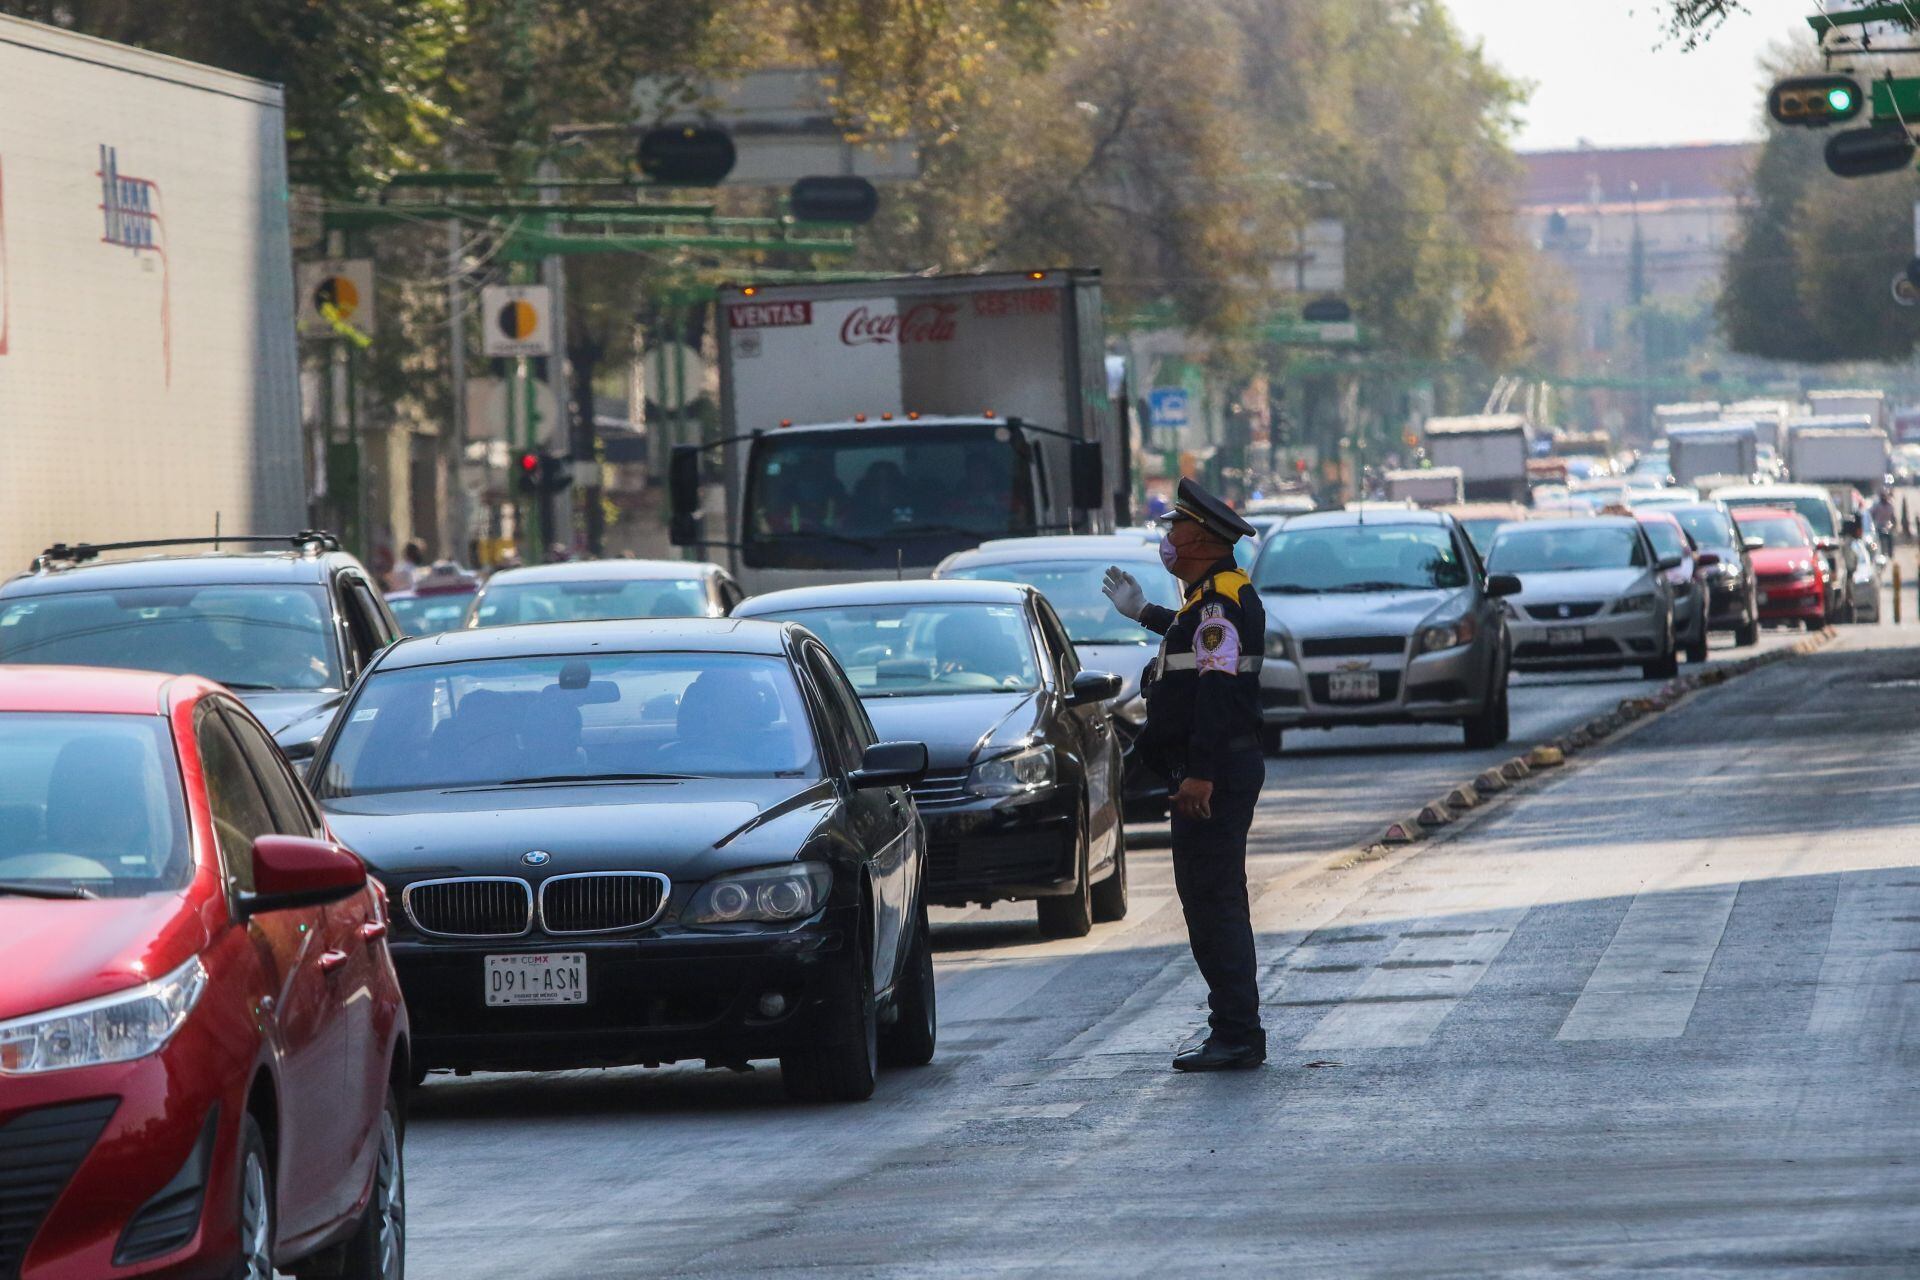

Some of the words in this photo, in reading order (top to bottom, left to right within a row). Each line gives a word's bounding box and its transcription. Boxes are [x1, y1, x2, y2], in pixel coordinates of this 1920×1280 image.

[732, 304, 805, 327] VENTAS
[841, 305, 900, 346] Coca
[898, 303, 958, 344] Cola
[492, 968, 579, 992] D91-ASN
